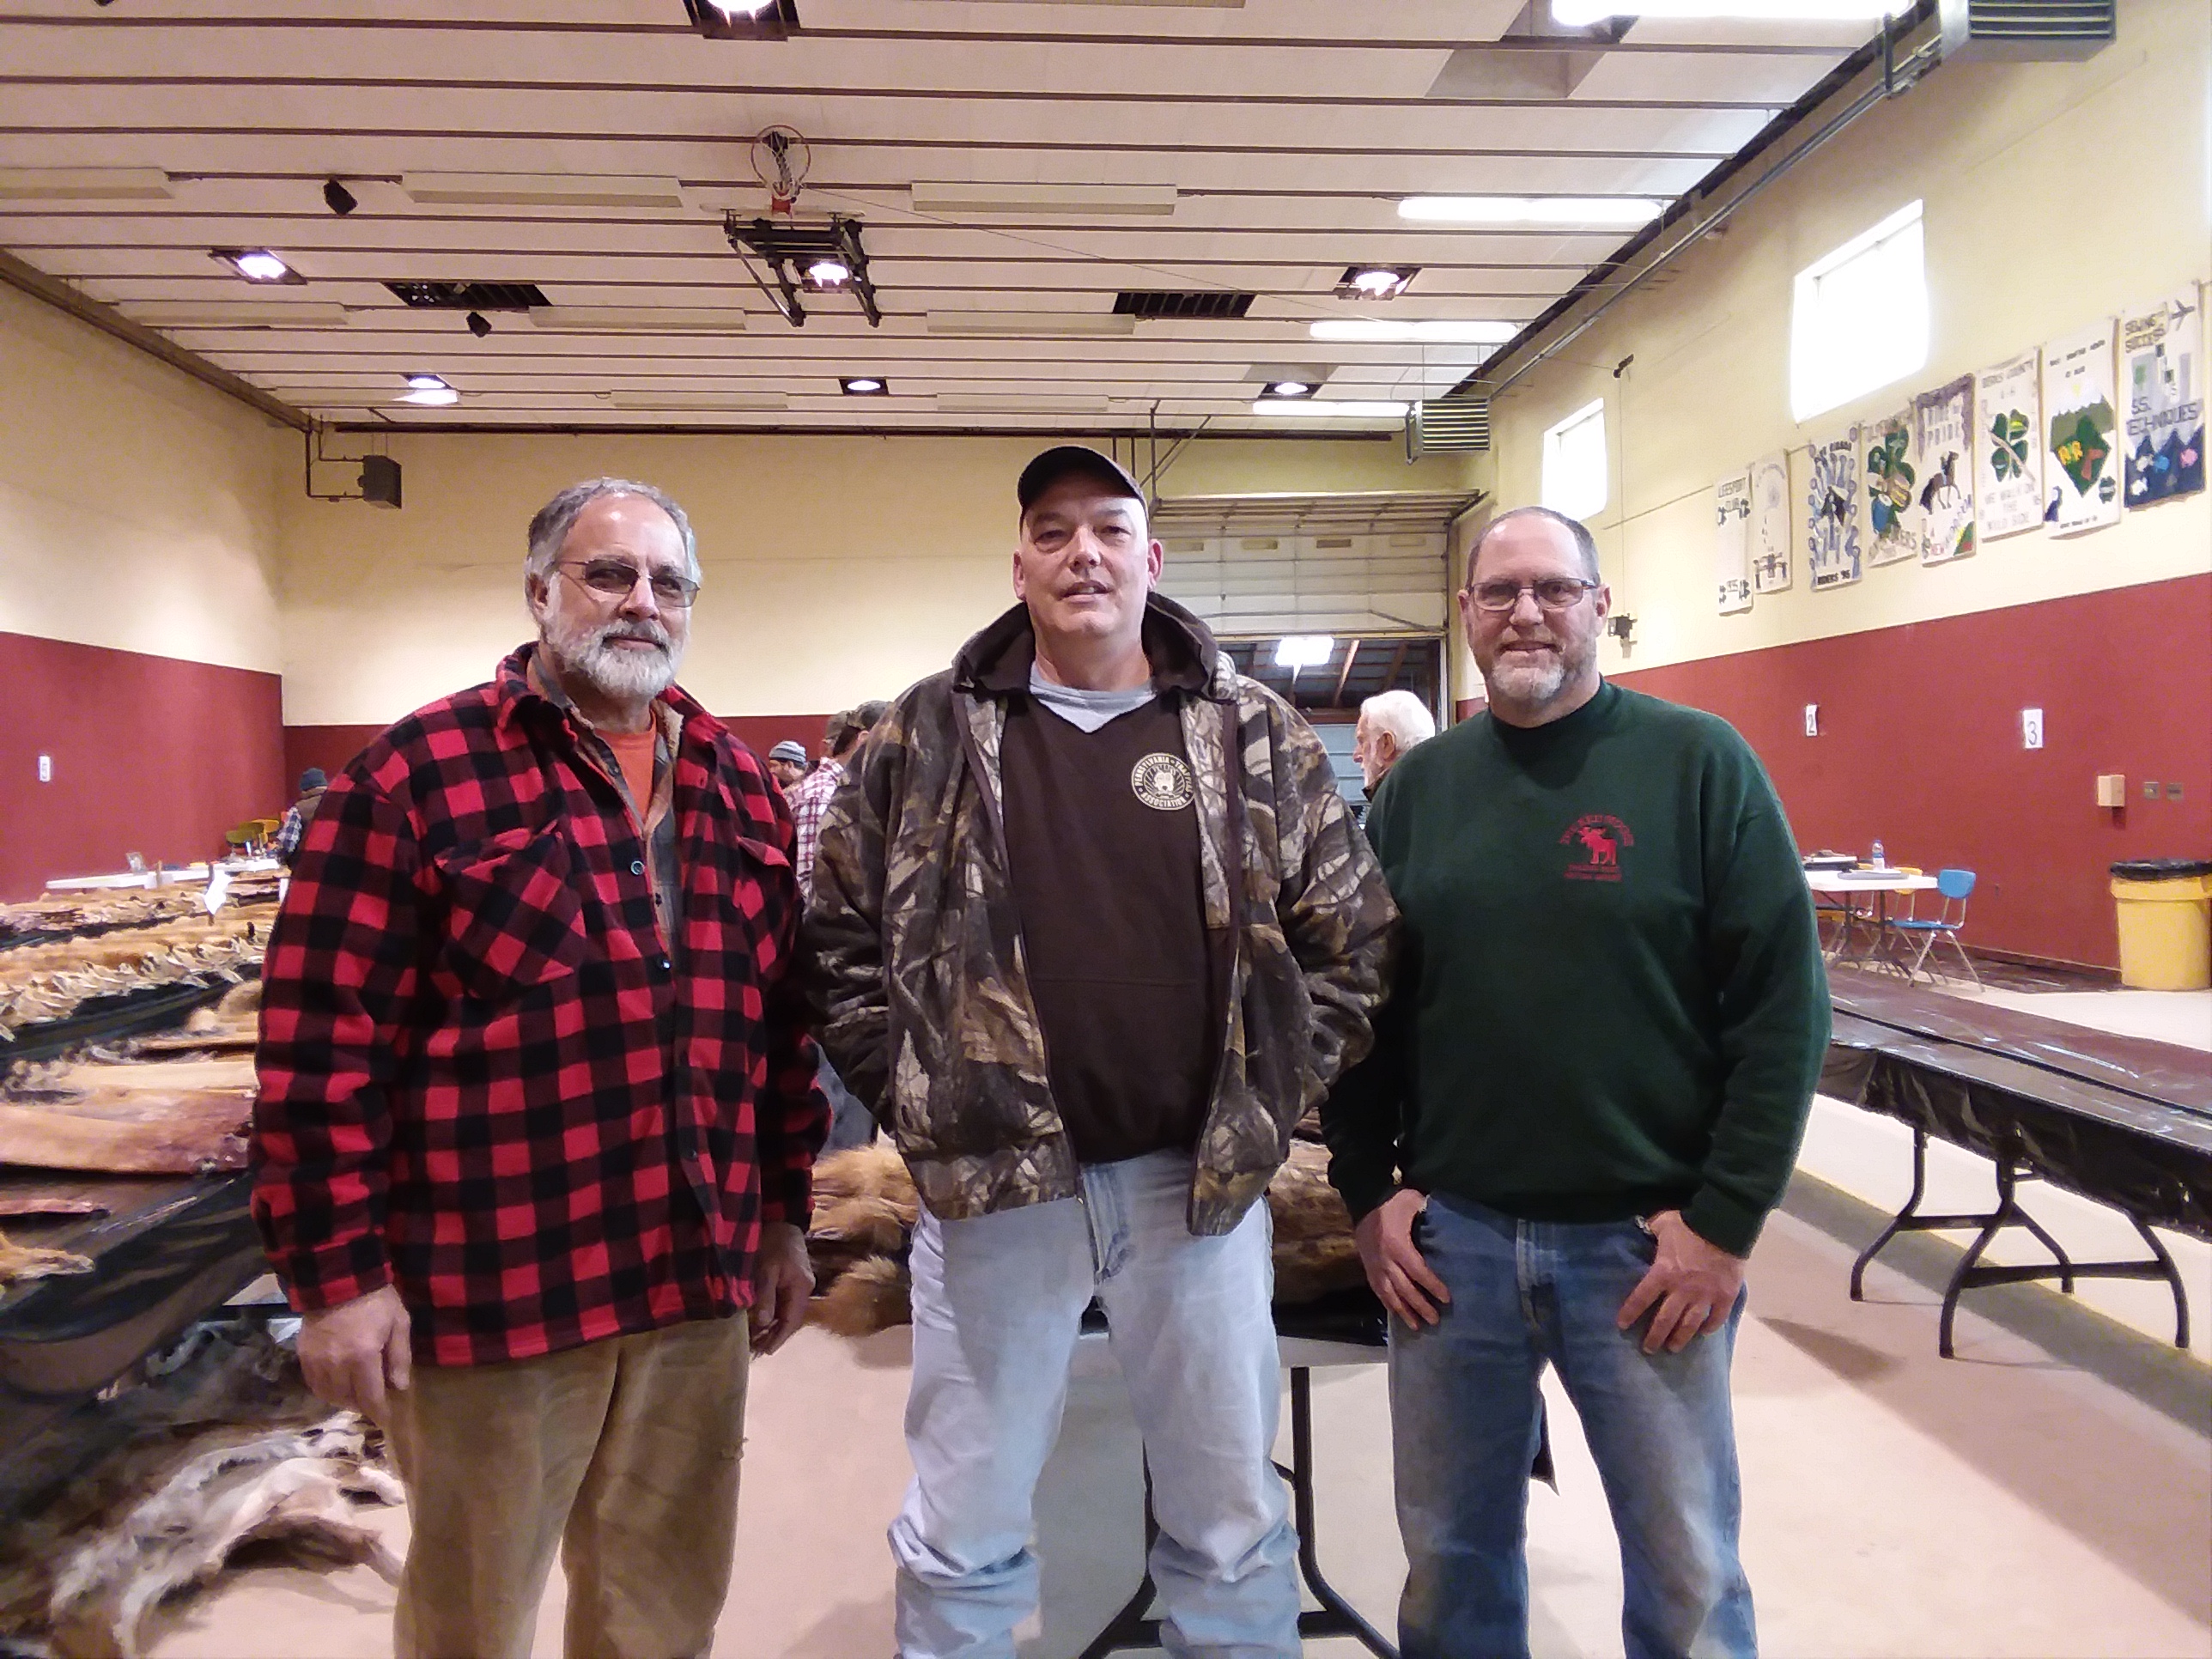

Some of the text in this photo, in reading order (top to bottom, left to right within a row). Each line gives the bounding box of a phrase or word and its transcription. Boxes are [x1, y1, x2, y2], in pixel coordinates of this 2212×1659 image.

[1808, 714, 1815, 733] 2
[2027, 720, 2038, 745] 3
[1134, 756, 1170, 787] PENNSYLVANIA
[1139, 792, 1187, 807] ASSOCIATION
